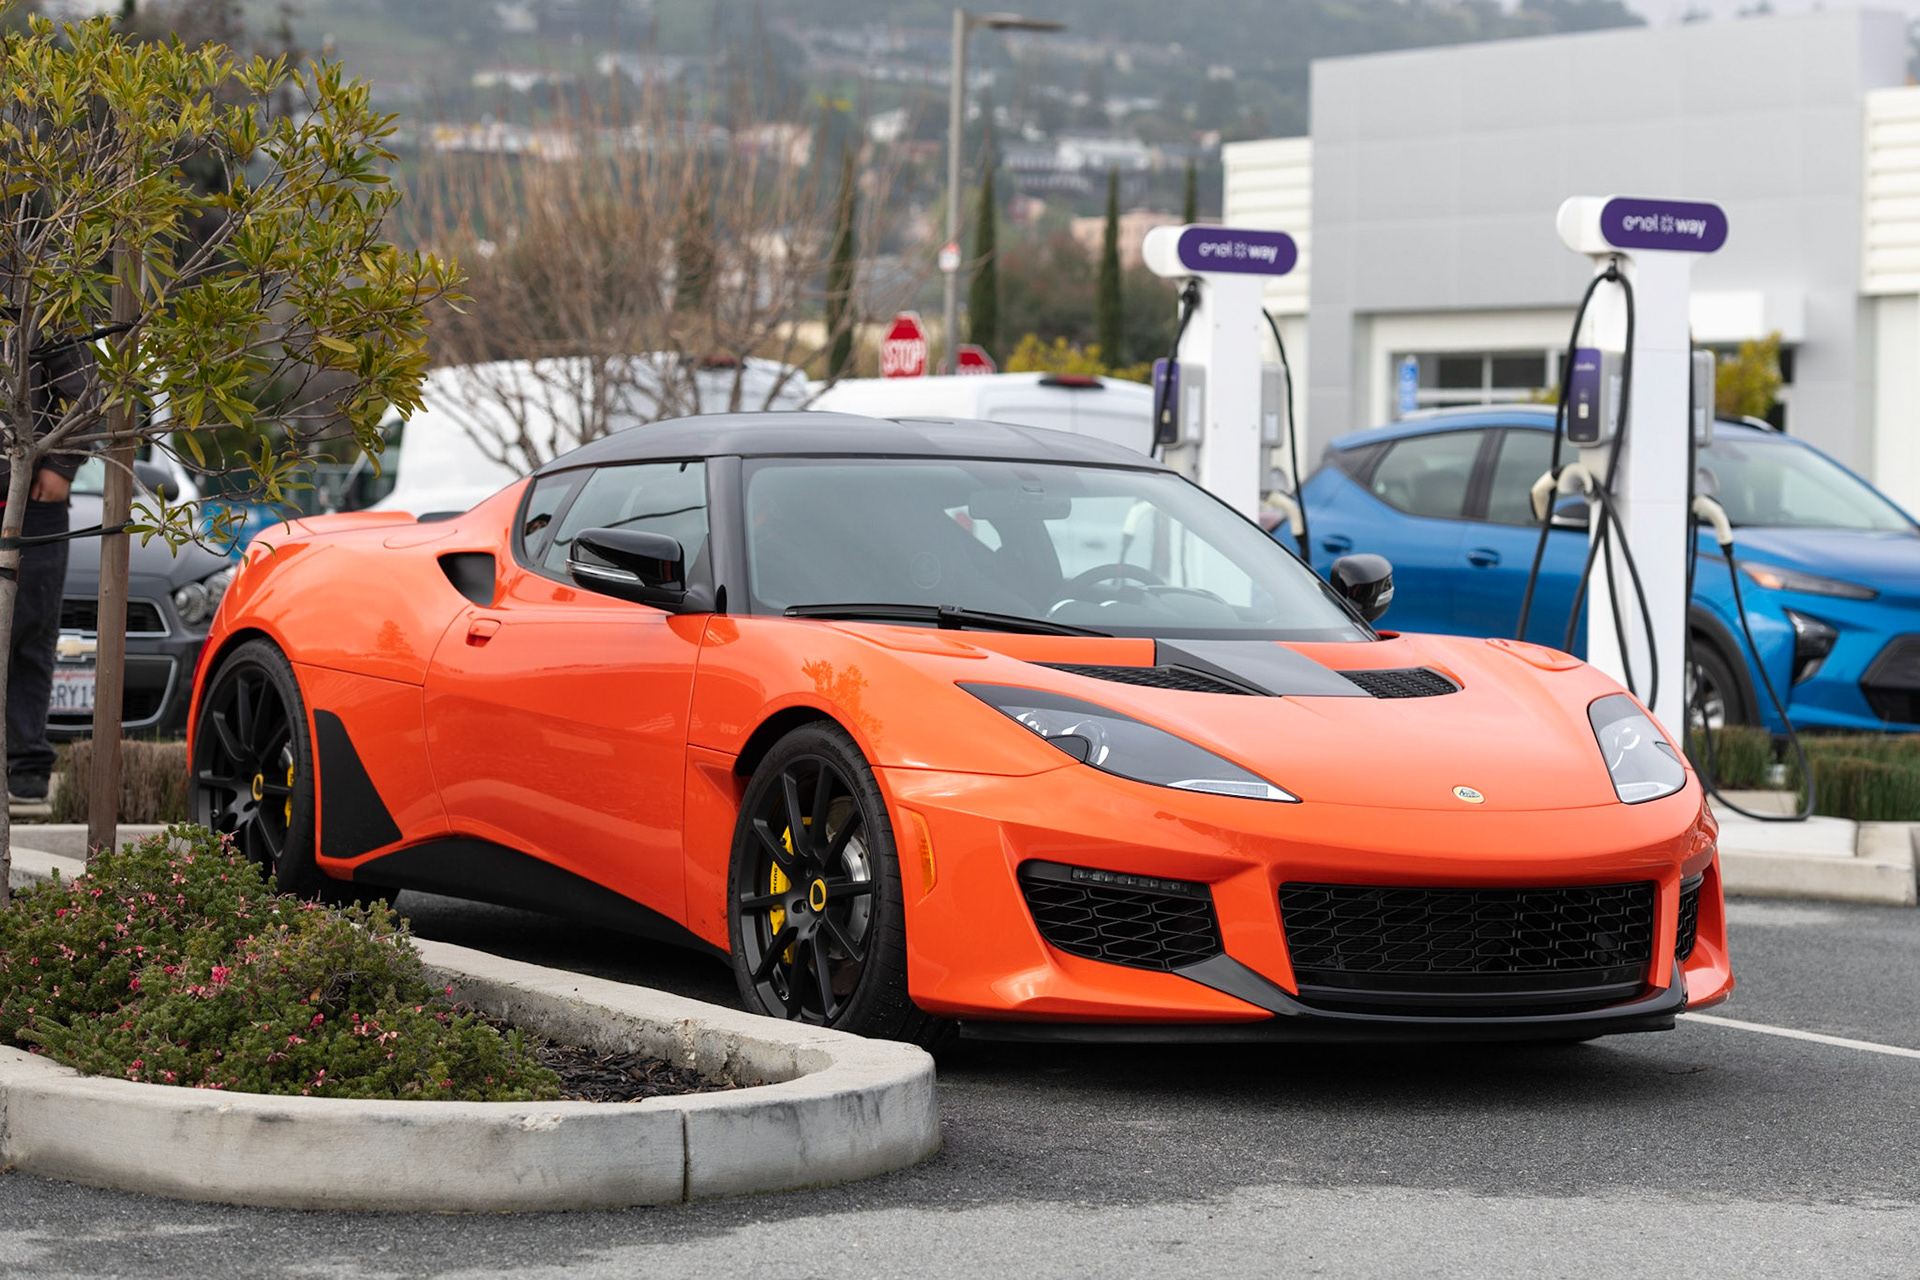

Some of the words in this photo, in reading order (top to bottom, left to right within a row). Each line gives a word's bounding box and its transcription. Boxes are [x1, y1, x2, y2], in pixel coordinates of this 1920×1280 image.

[1675, 219, 1708, 239] way
[1248, 245, 1279, 264] way
[882, 338, 926, 374] STOP
